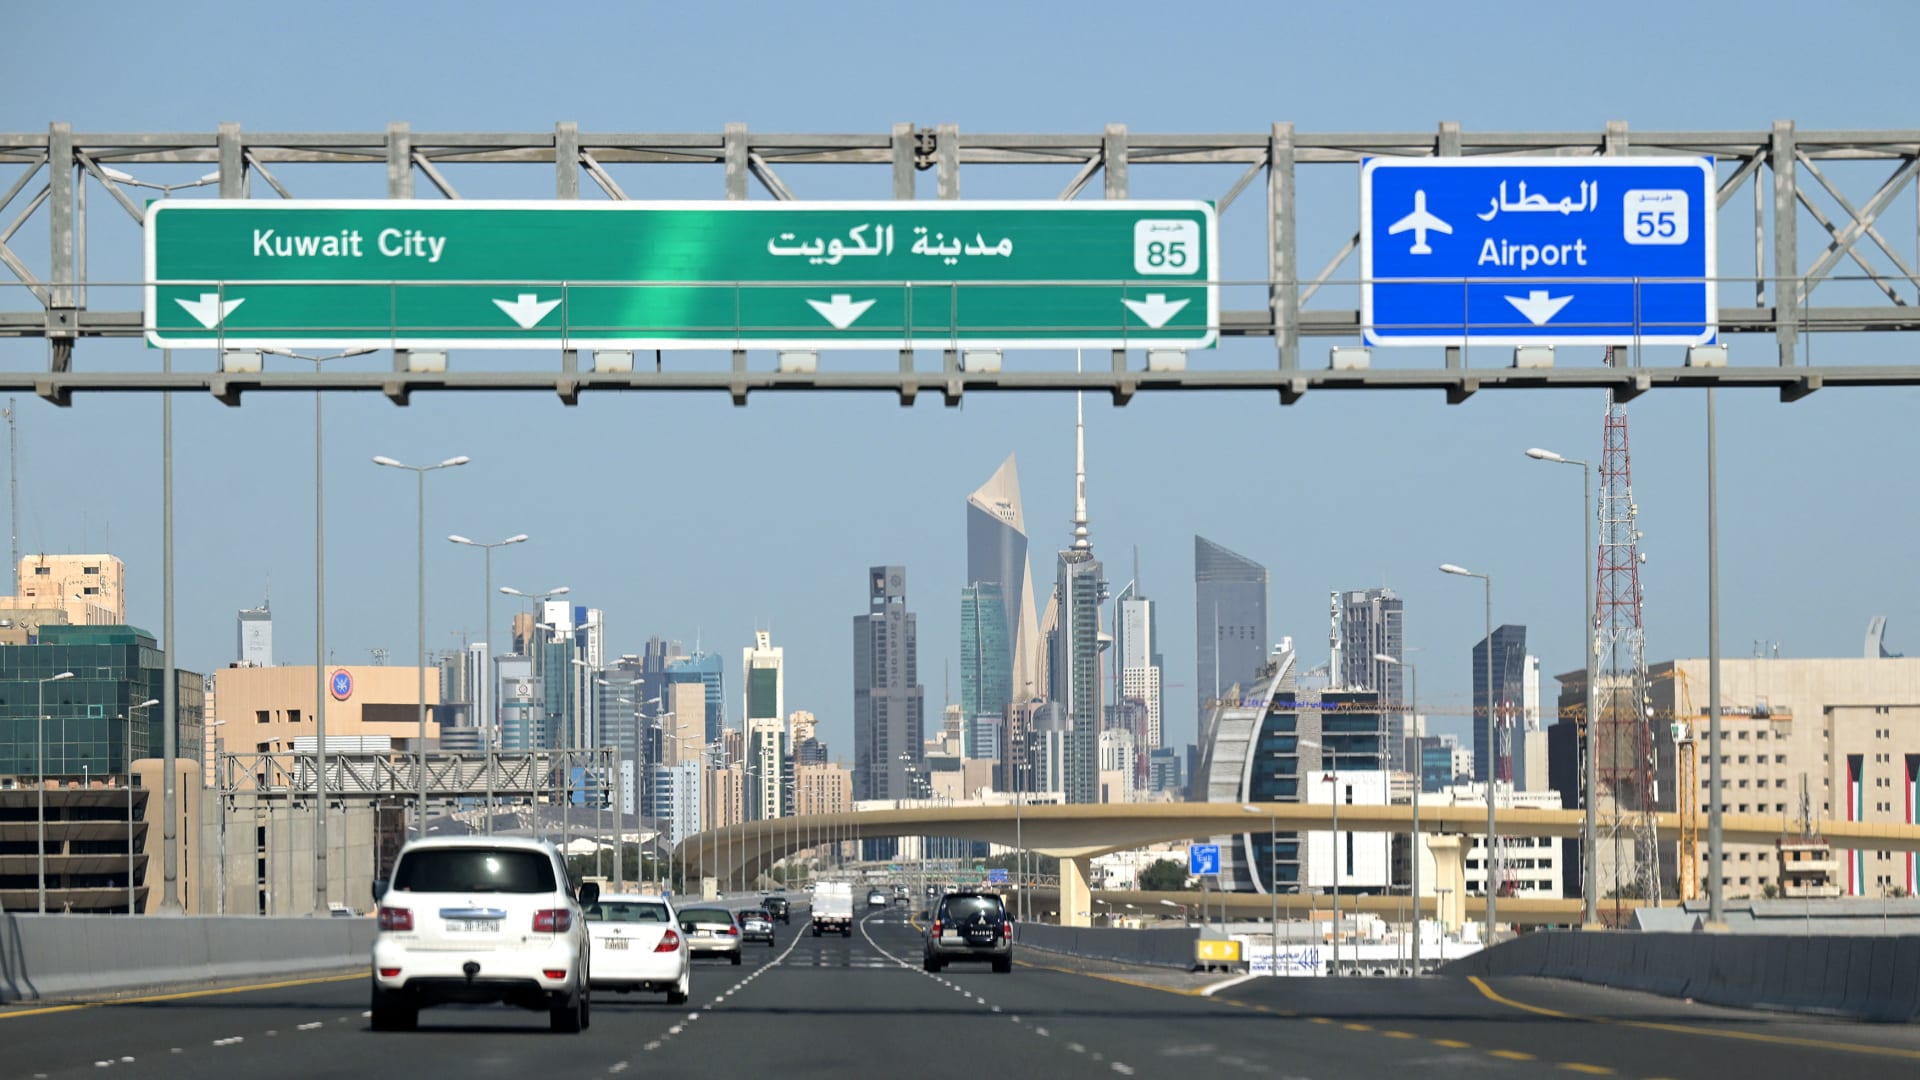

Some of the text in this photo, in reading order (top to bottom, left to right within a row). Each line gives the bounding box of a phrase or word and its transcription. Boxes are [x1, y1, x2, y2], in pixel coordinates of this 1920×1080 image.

[1477, 180, 1598, 222] المطار
[1637, 211, 1676, 238] 55
[253, 228, 447, 263] Kuwait City
[767, 223, 1013, 265] مدينة الكويت
[1147, 241, 1187, 268] 85
[1478, 238, 1587, 271] Airport
